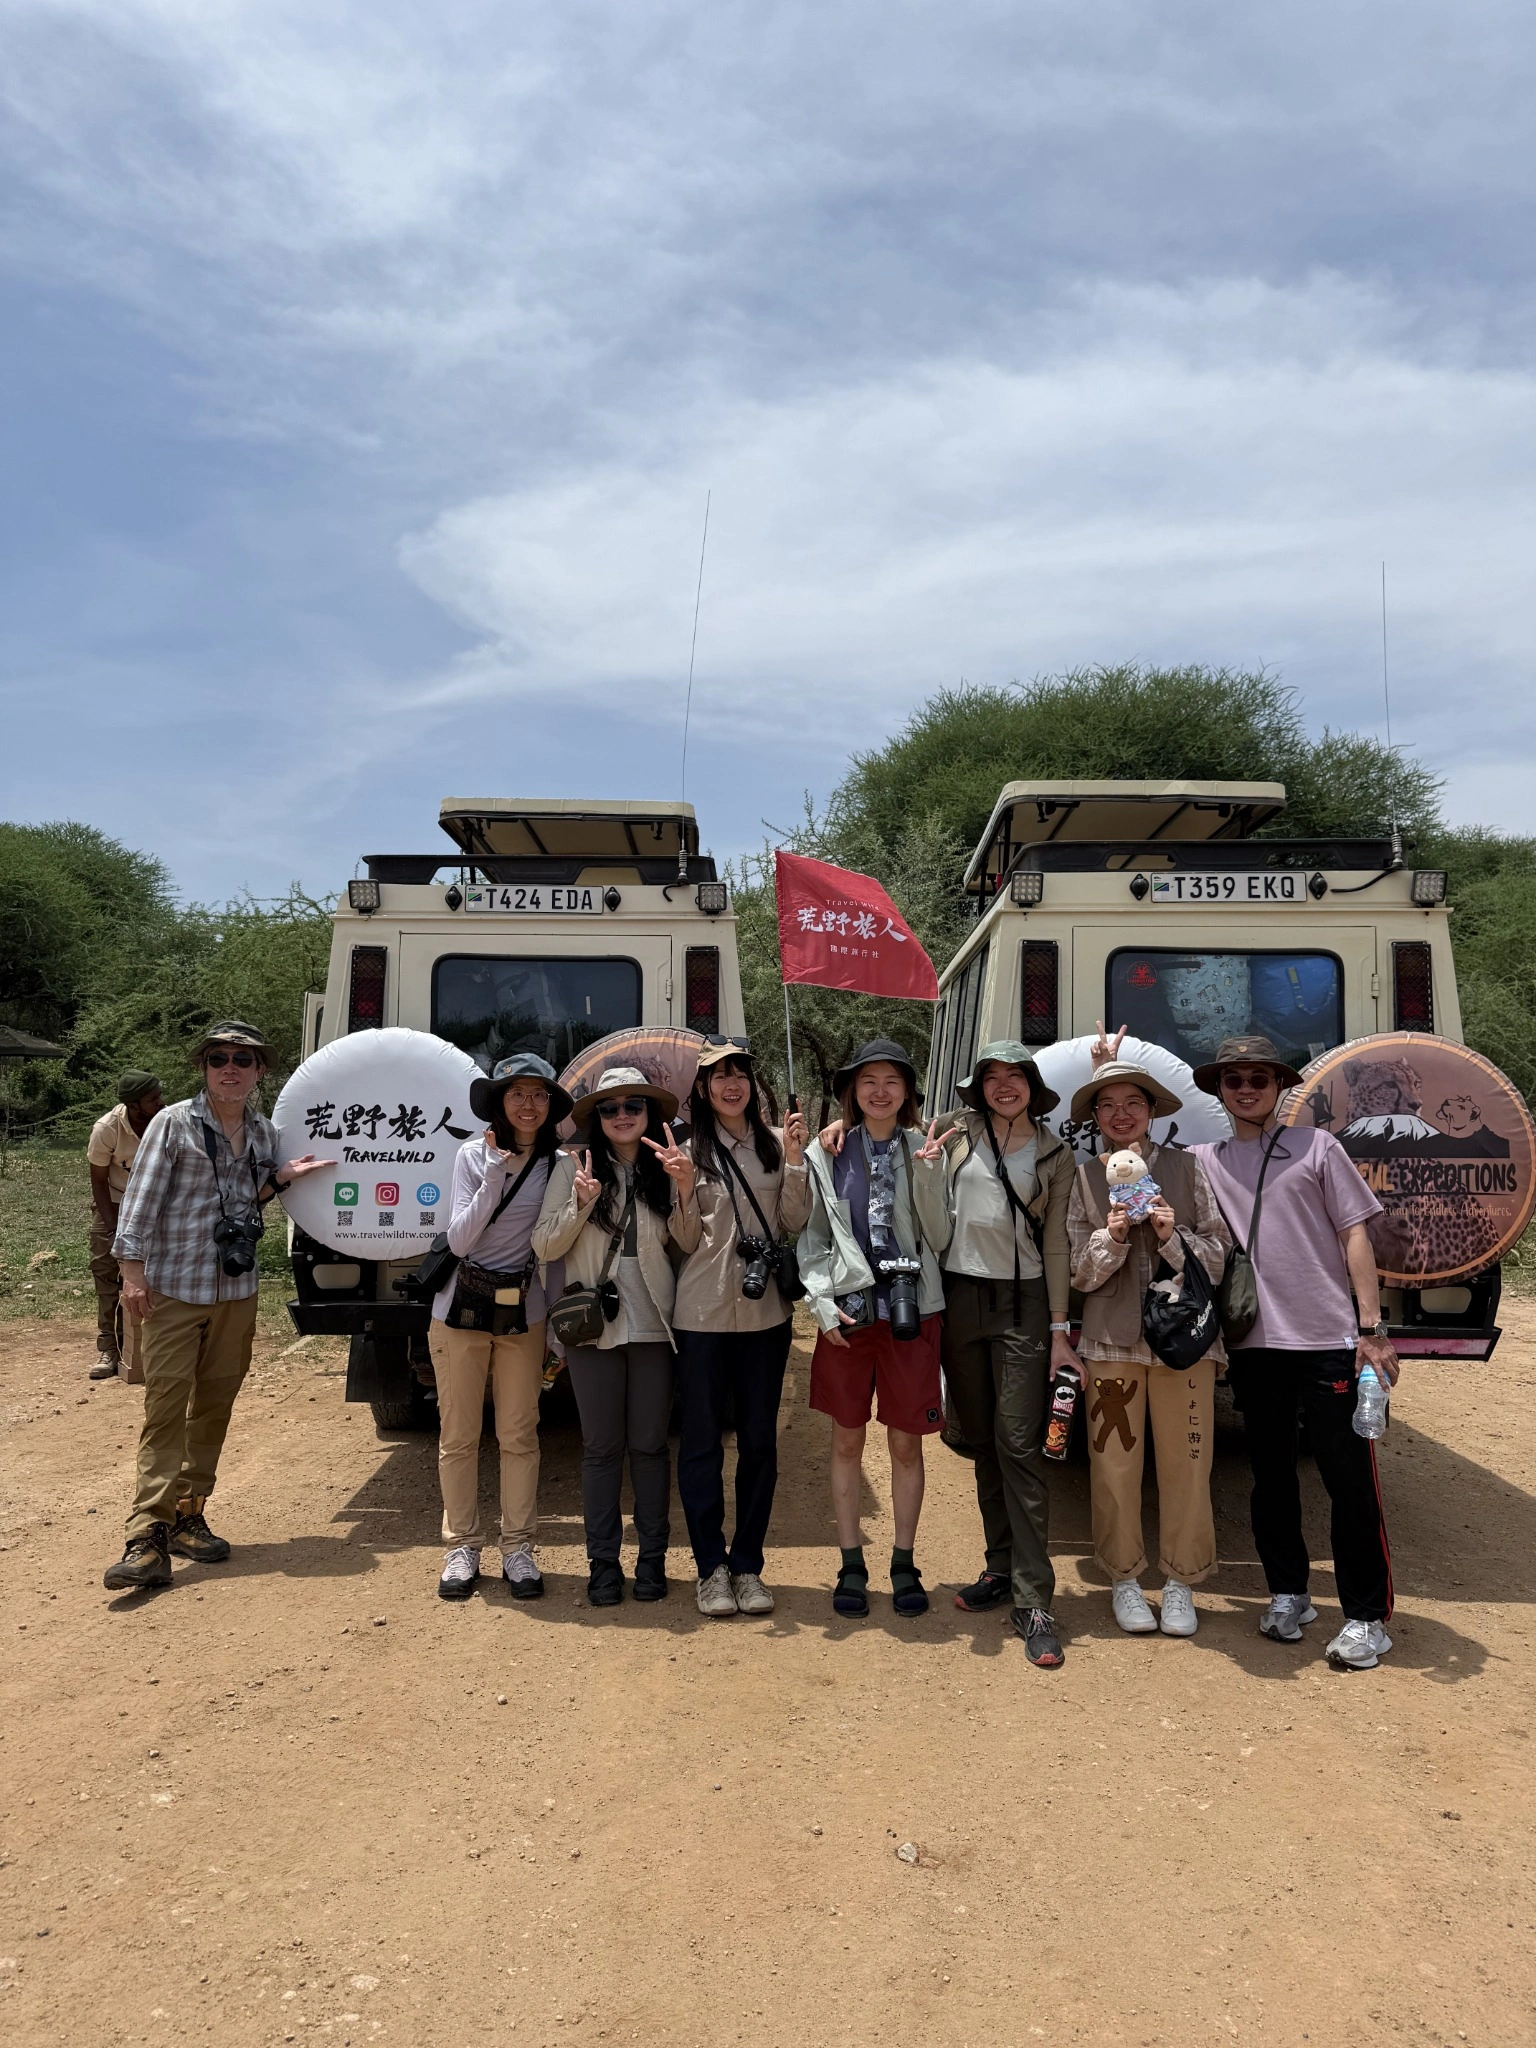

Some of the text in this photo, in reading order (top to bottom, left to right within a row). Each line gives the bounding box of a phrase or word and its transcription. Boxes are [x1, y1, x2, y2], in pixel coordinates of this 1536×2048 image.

[485, 888, 593, 910] T424 EDA
[1174, 876, 1295, 899] T359 EKQ
[796, 905, 908, 942] 荒野旅人
[304, 1100, 475, 1142] 荒野旅人
[1354, 1161, 1518, 1192] FUL EXPEDITIONS
[334, 1230, 438, 1239] www.travelwildtw.com
